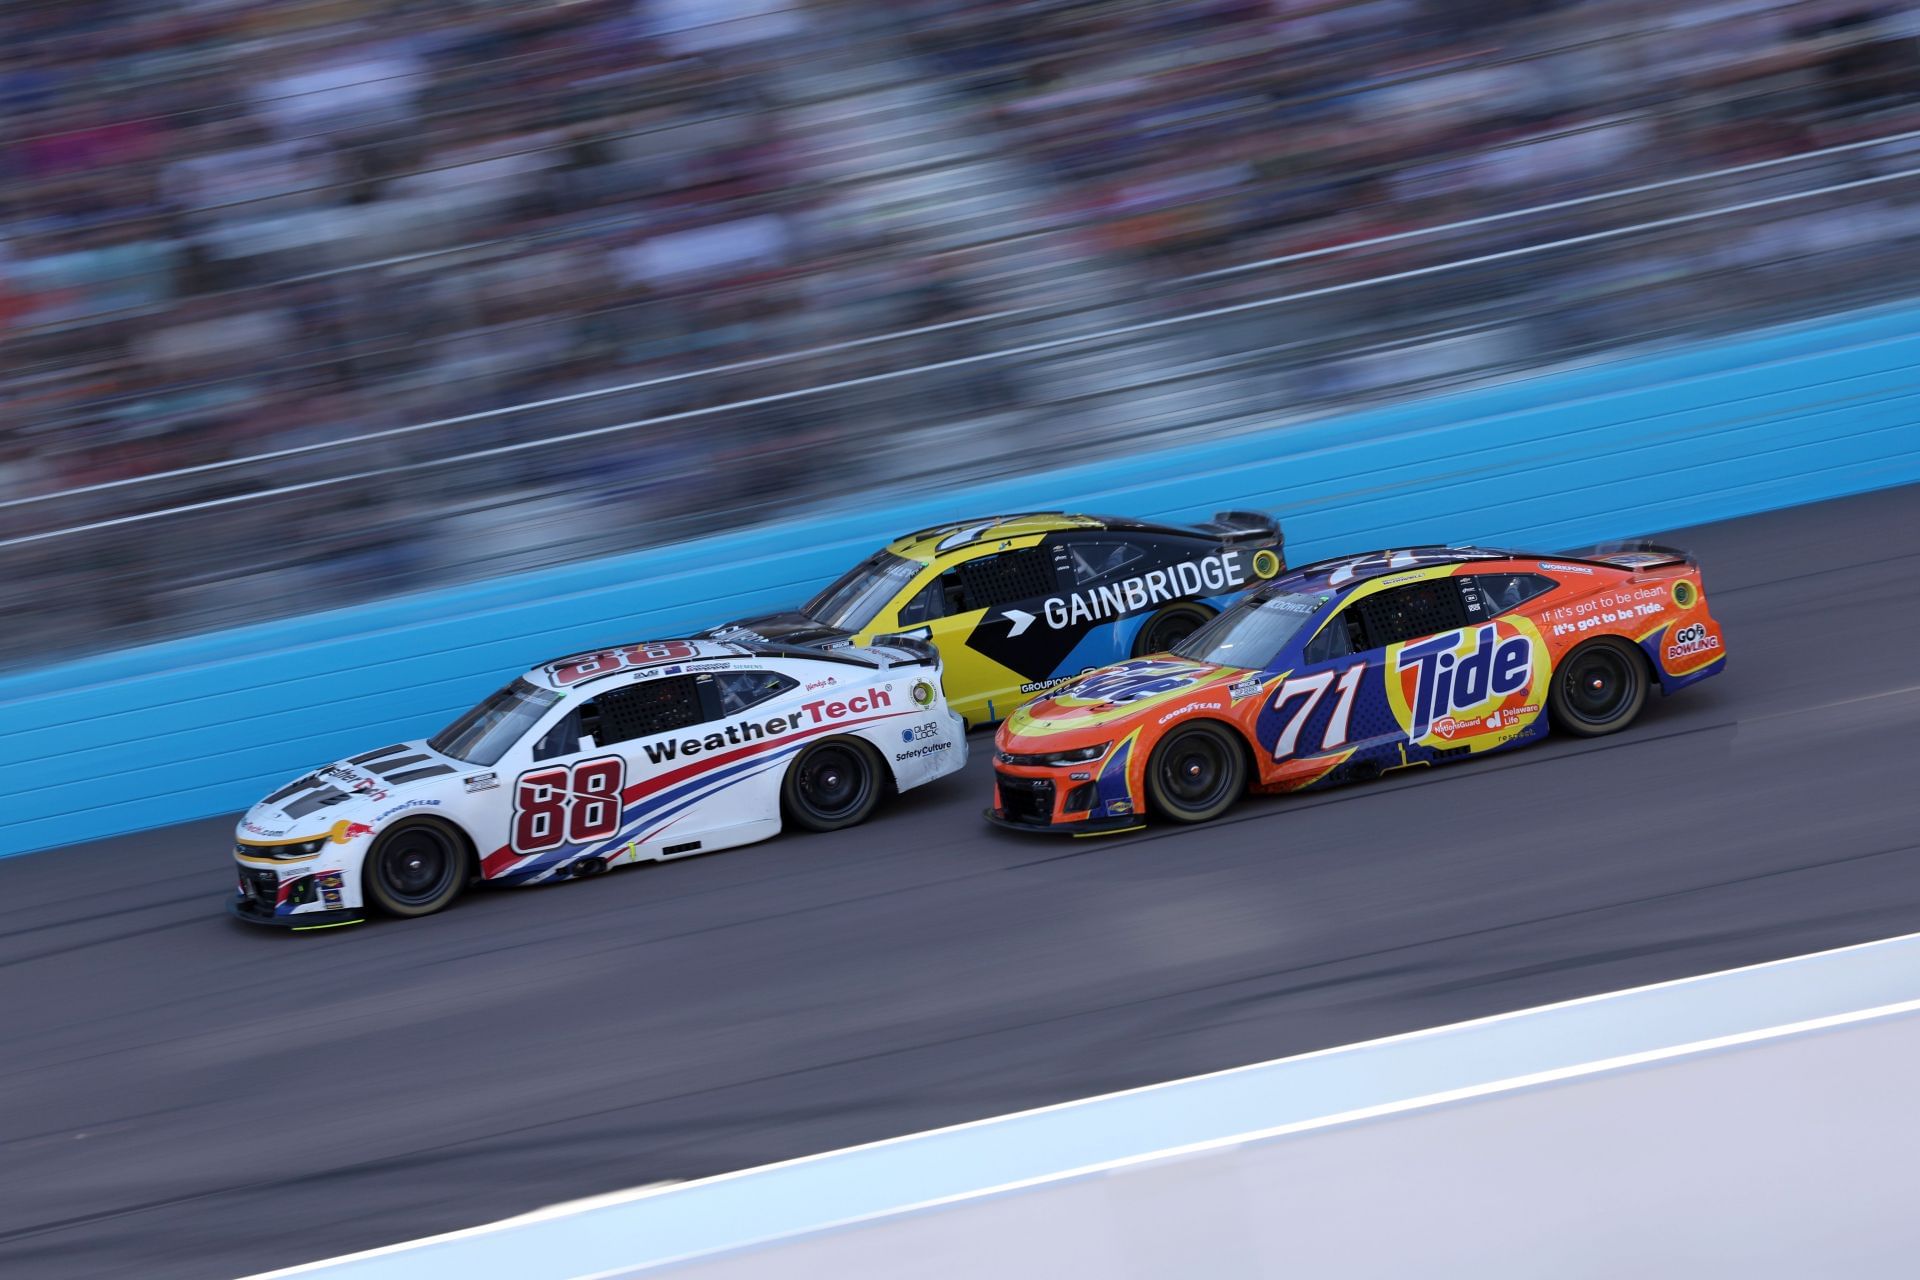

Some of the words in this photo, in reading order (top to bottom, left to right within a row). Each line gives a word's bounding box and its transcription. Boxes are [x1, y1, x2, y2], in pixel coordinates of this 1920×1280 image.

[1043, 551, 1246, 630] GAINBRIDGE
[1541, 610, 1551, 623] If
[1553, 604, 1574, 620] it's
[1575, 598, 1598, 616] got
[1600, 597, 1614, 608] to
[1615, 592, 1632, 604] be
[1633, 586, 1668, 601] clean,
[1577, 616, 1601, 633] got
[1601, 613, 1617, 624] to
[1618, 609, 1634, 621] be
[1633, 602, 1665, 618] Tide.
[1668, 636, 1718, 659] BOWLING
[1396, 622, 1534, 746] Tide
[1158, 702, 1222, 725] GOODYEAR
[1272, 662, 1368, 762] 71
[1502, 704, 1539, 717] Delaware
[1504, 716, 1519, 726] Life
[642, 688, 892, 765] WeatherTech
[913, 721, 938, 734] QUAD
[914, 729, 938, 741] LOCK
[1434, 716, 1482, 734] NationsGuard
[896, 741, 952, 762] SafetyCulture
[511, 754, 627, 855] 88
